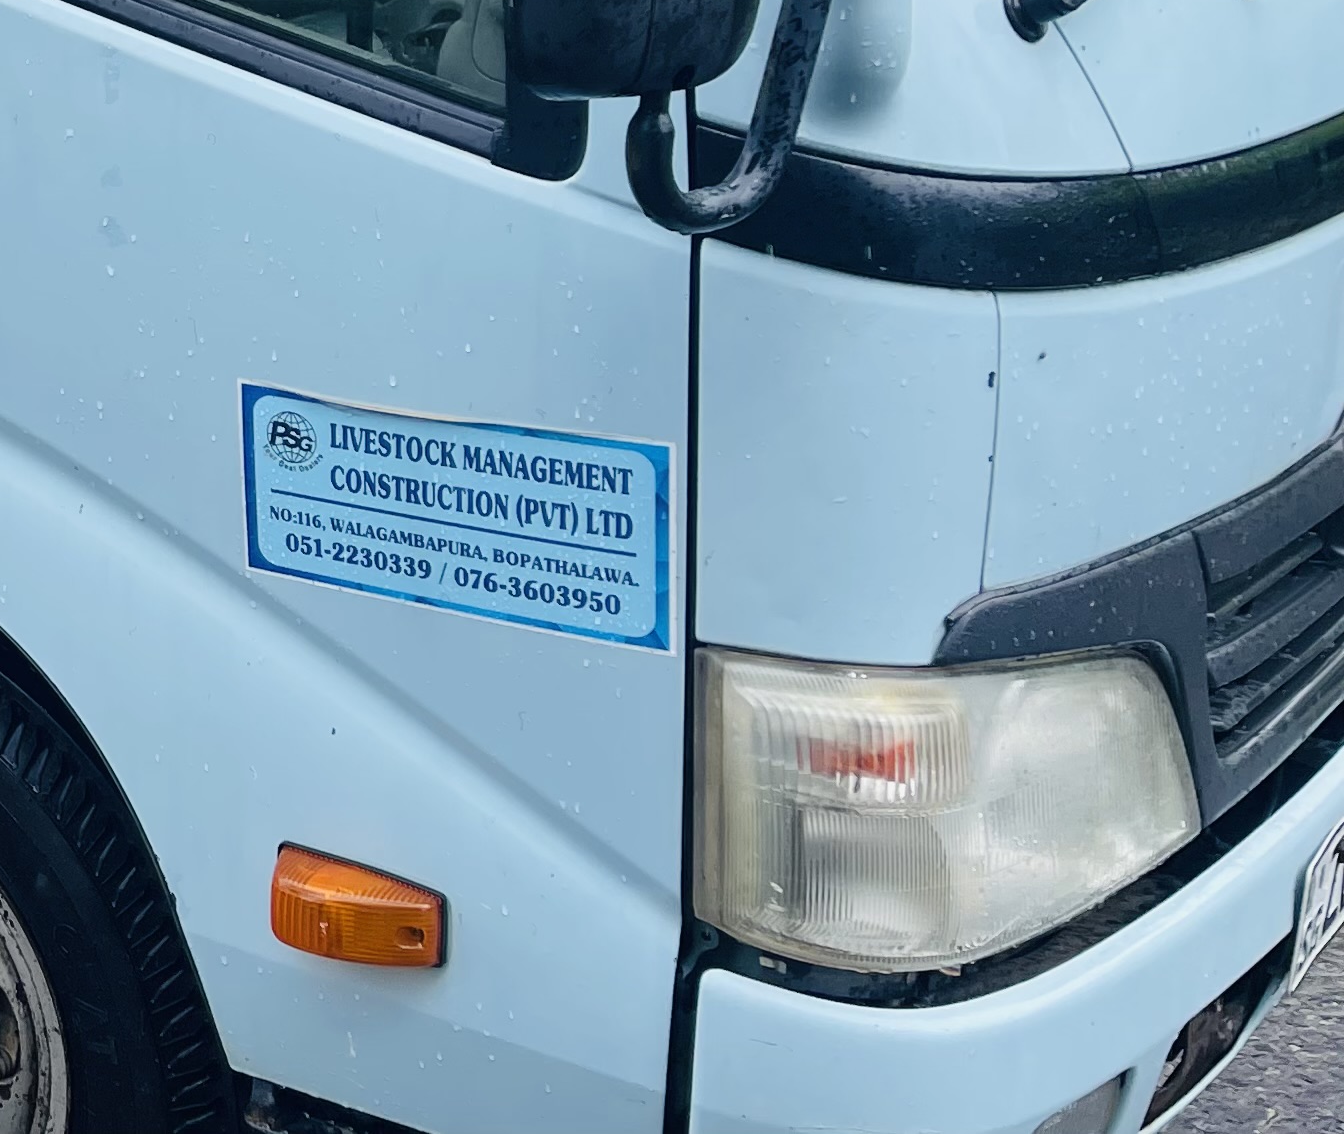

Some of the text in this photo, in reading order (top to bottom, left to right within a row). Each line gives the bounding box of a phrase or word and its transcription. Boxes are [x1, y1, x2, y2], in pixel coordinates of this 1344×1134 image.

[269, 421, 314, 451] PSG
[330, 422, 634, 496] LIVESTOCK MANAGEMENT
[330, 465, 633, 540] CONSTRUCTION (PVT) LTD
[269, 506, 640, 587] NO:116, WALAGAMBAPURA, BOPATHALAWA.
[285, 533, 432, 580] 051-2230339
[454, 567, 621, 615] 076-3603950
